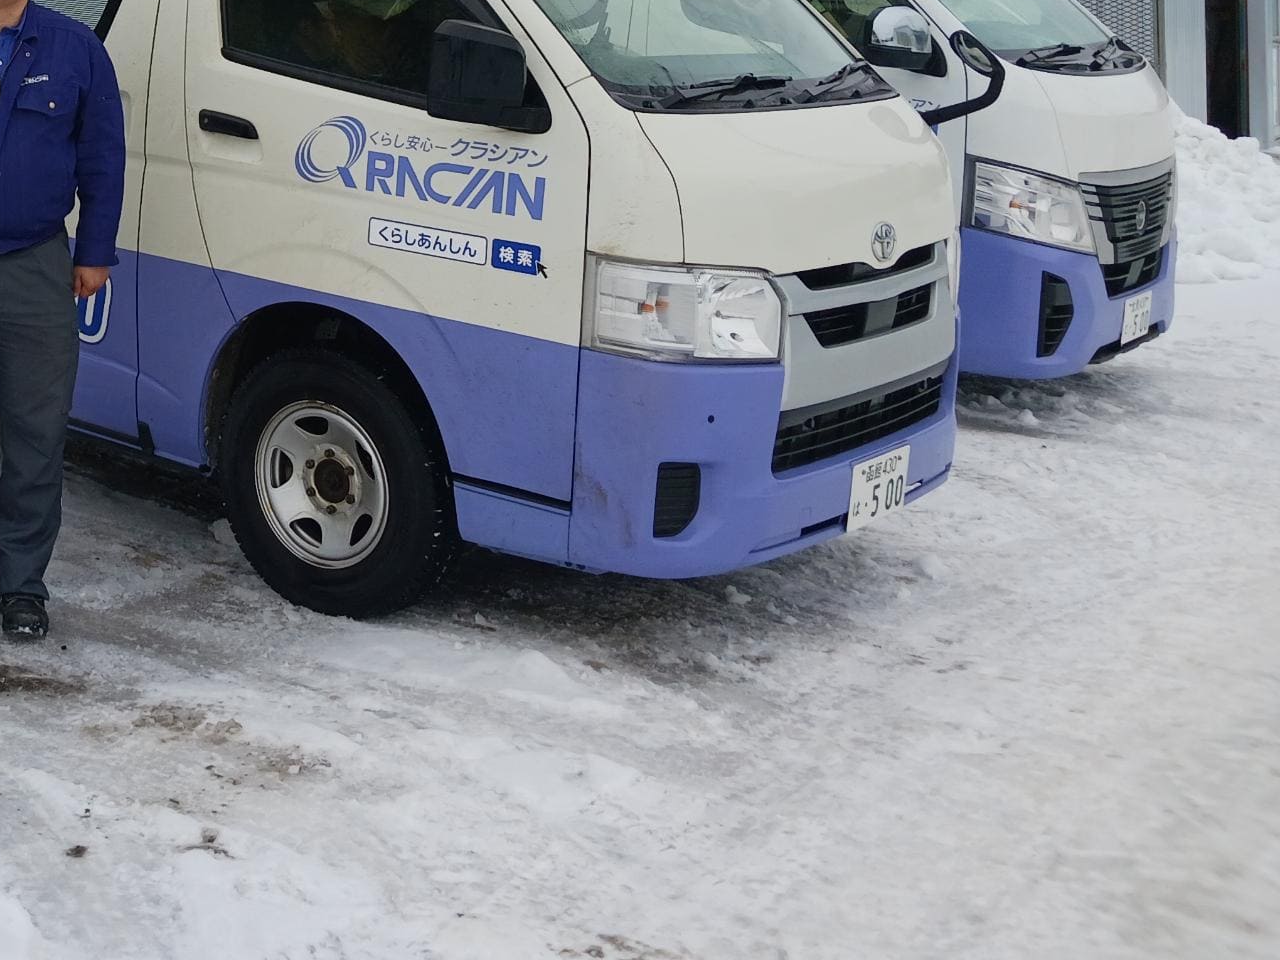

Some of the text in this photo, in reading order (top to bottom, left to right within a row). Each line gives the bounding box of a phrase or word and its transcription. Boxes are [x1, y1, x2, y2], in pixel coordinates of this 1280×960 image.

[379, 226, 534, 268] くらしあんしん 検索
